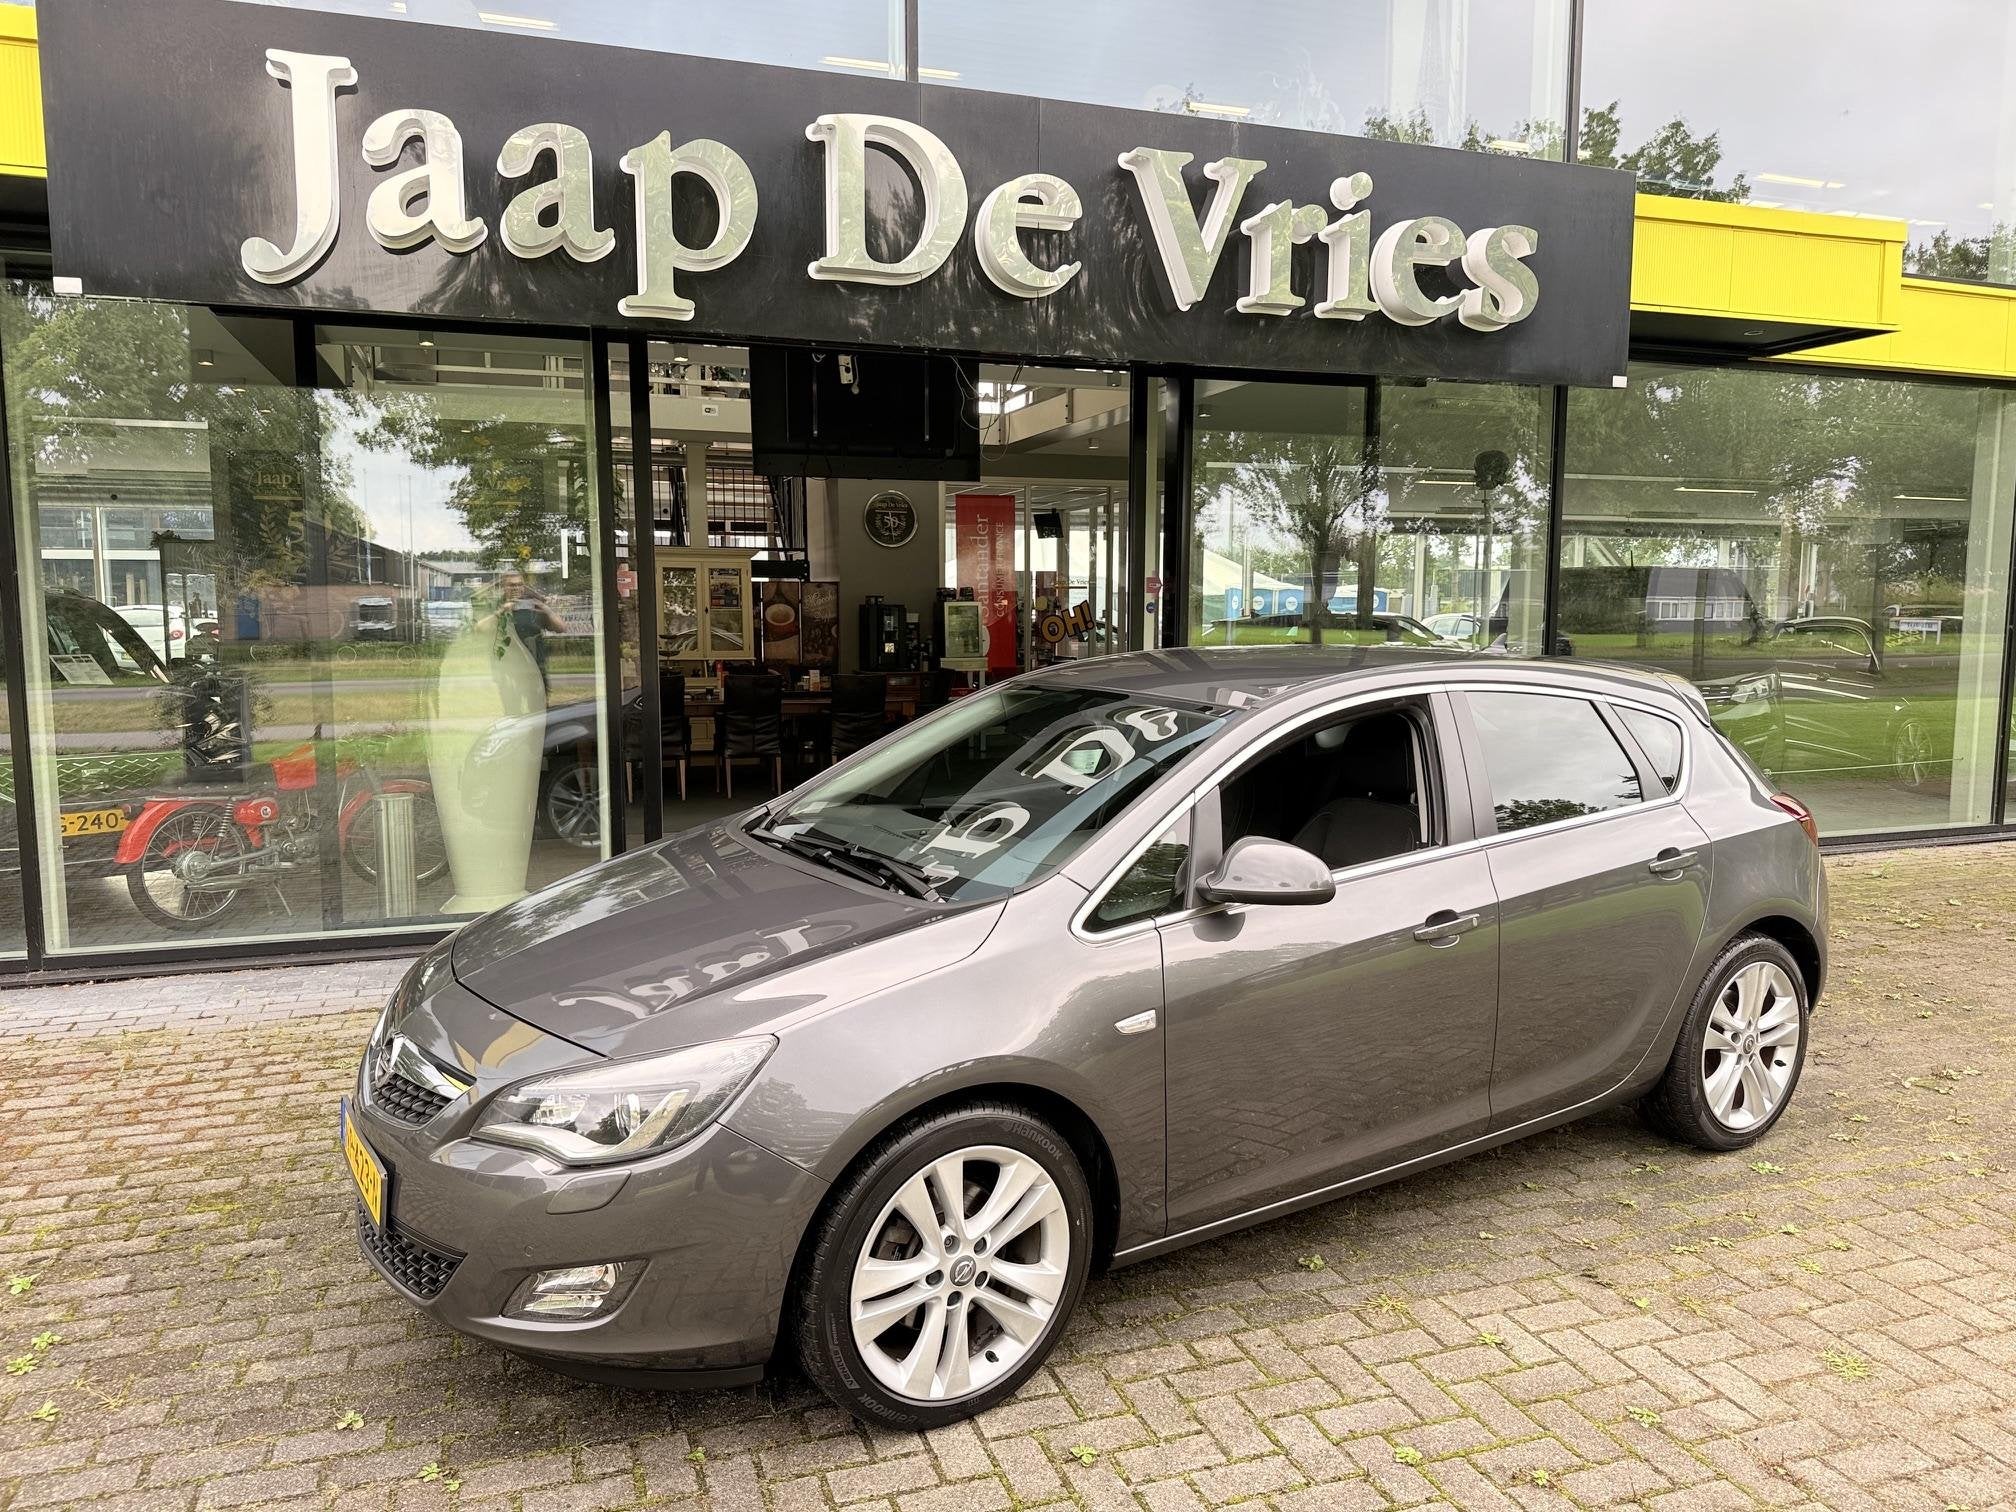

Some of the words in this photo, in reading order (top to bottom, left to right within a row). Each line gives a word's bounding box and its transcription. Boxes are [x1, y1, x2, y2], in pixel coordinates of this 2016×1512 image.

[241, 48, 758, 322] Jaap
[805, 113, 1083, 299] De
[1117, 147, 1540, 333] Vries
[1041, 600, 1095, 643] OH!
